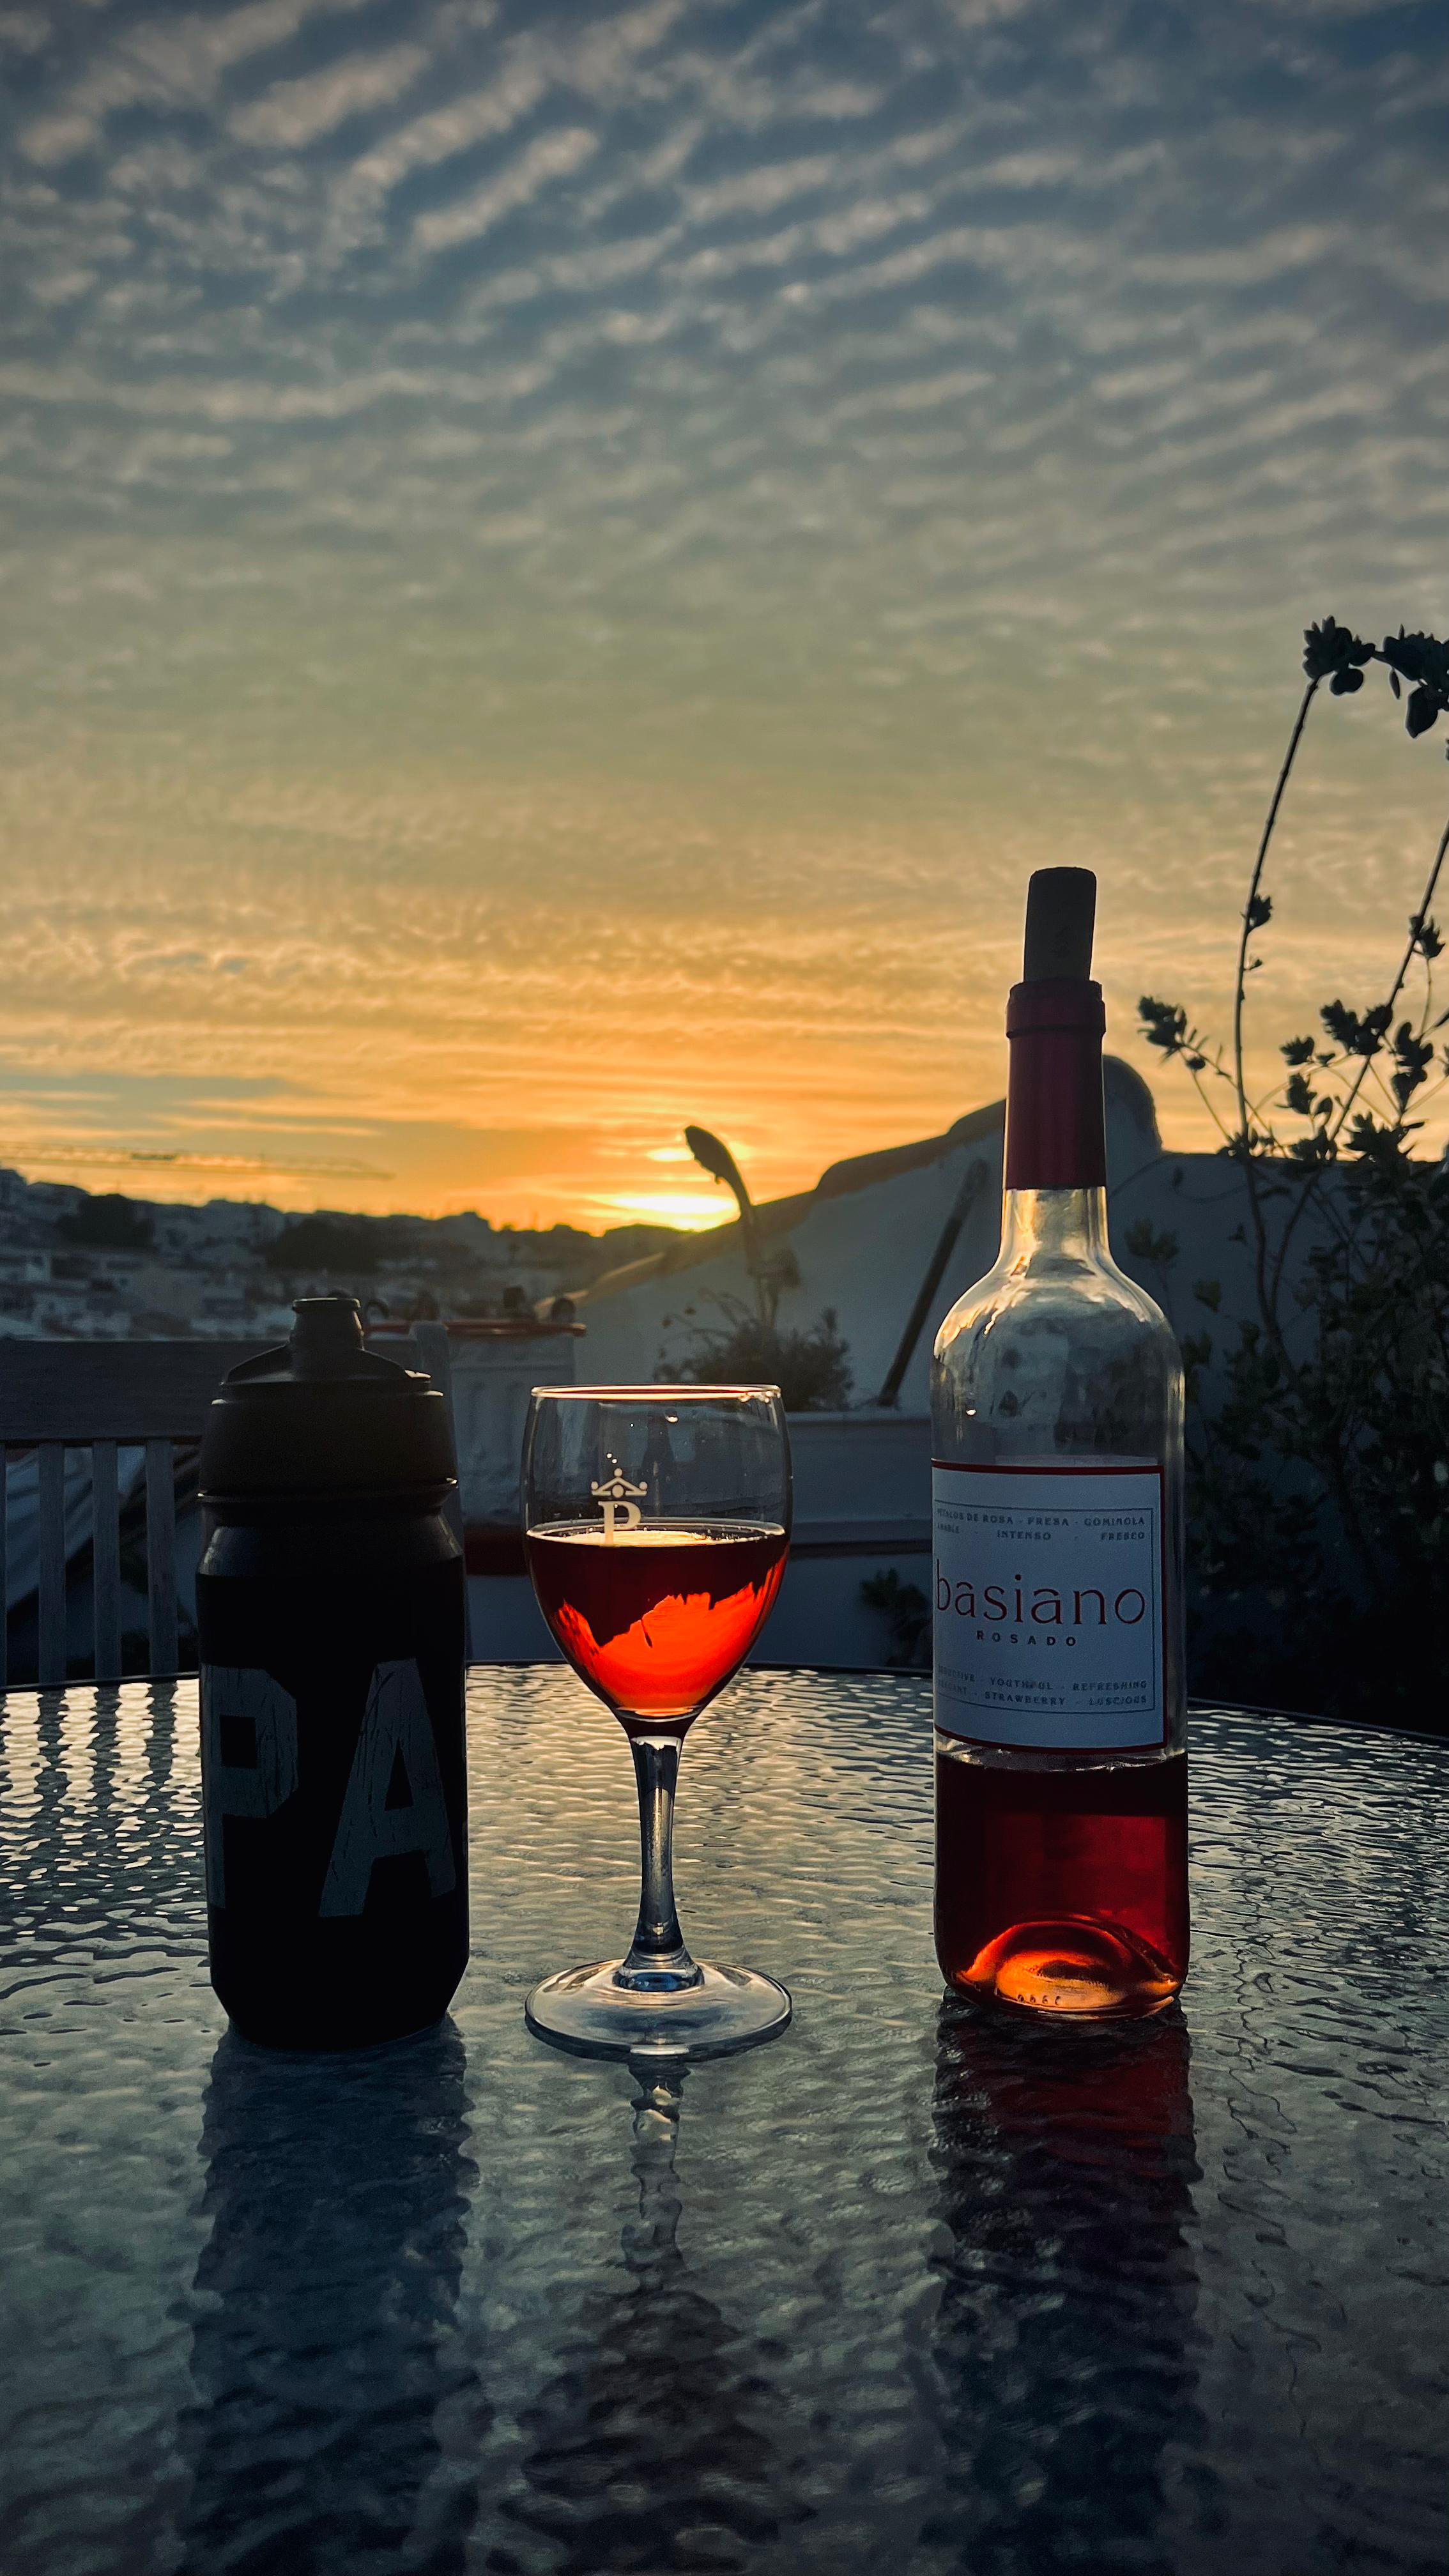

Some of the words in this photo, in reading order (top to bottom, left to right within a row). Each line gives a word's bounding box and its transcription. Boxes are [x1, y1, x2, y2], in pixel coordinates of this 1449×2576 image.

[967, 1512, 979, 1522] DE
[983, 1514, 1013, 1524] ROSA
[1027, 1517, 1070, 1526] FRESA
[1084, 1517, 1145, 1526] GOMINOLA
[997, 1530, 1052, 1540] INTENSO
[1101, 1531, 1145, 1540] FRESCO
[937, 1558, 1146, 1625] basiano
[976, 1630, 1077, 1646] ROSADO
[1073, 1680, 1147, 1691] REFRESHING
[985, 1691, 1066, 1705] STRAWBERRY
